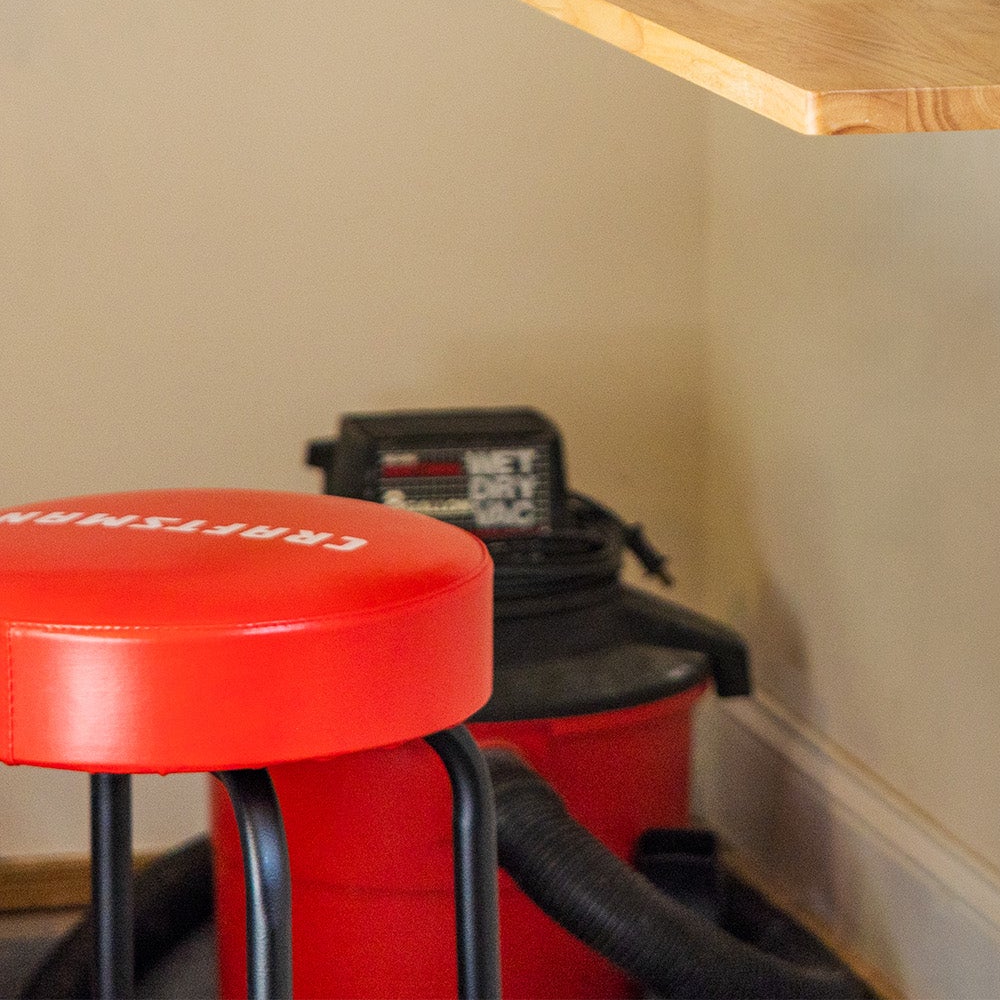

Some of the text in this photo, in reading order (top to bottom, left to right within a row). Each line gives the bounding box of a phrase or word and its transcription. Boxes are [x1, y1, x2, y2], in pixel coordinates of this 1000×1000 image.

[466, 449, 535, 474] WET
[469, 474, 538, 499] DRY
[474, 499, 535, 525] VAC
[0, 511, 367, 551] CRAFTSMAN
